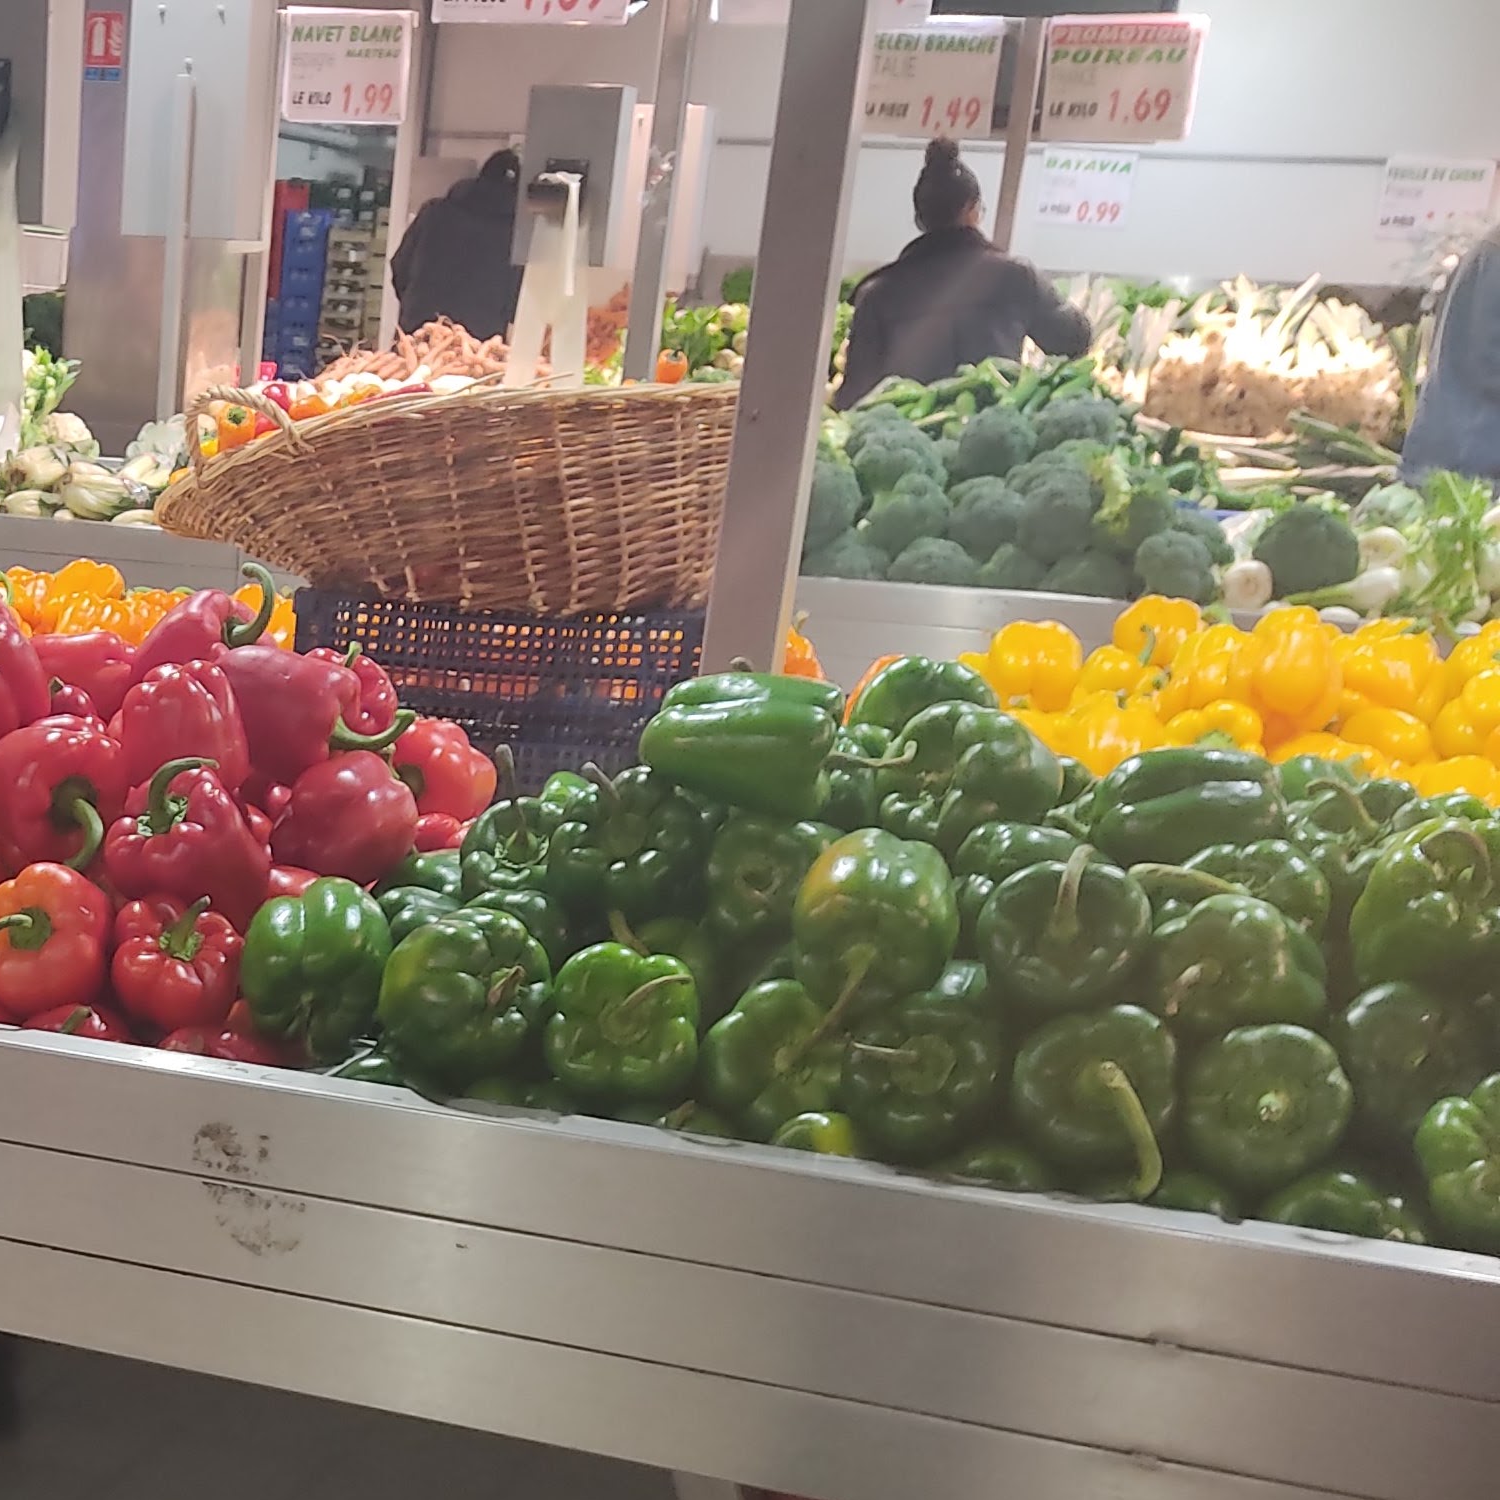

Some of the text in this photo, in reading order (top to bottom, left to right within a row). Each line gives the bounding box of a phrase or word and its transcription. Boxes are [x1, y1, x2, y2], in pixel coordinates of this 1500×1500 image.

[291, 25, 402, 42] NAVET BLANC
[1052, 24, 1189, 44] PROMOTION
[924, 33, 999, 54] BRANCHE
[1051, 47, 1189, 64] POIREAU
[292, 91, 305, 104] LE
[342, 83, 393, 116] 1,99
[1046, 157, 1132, 173] BATAVIA
